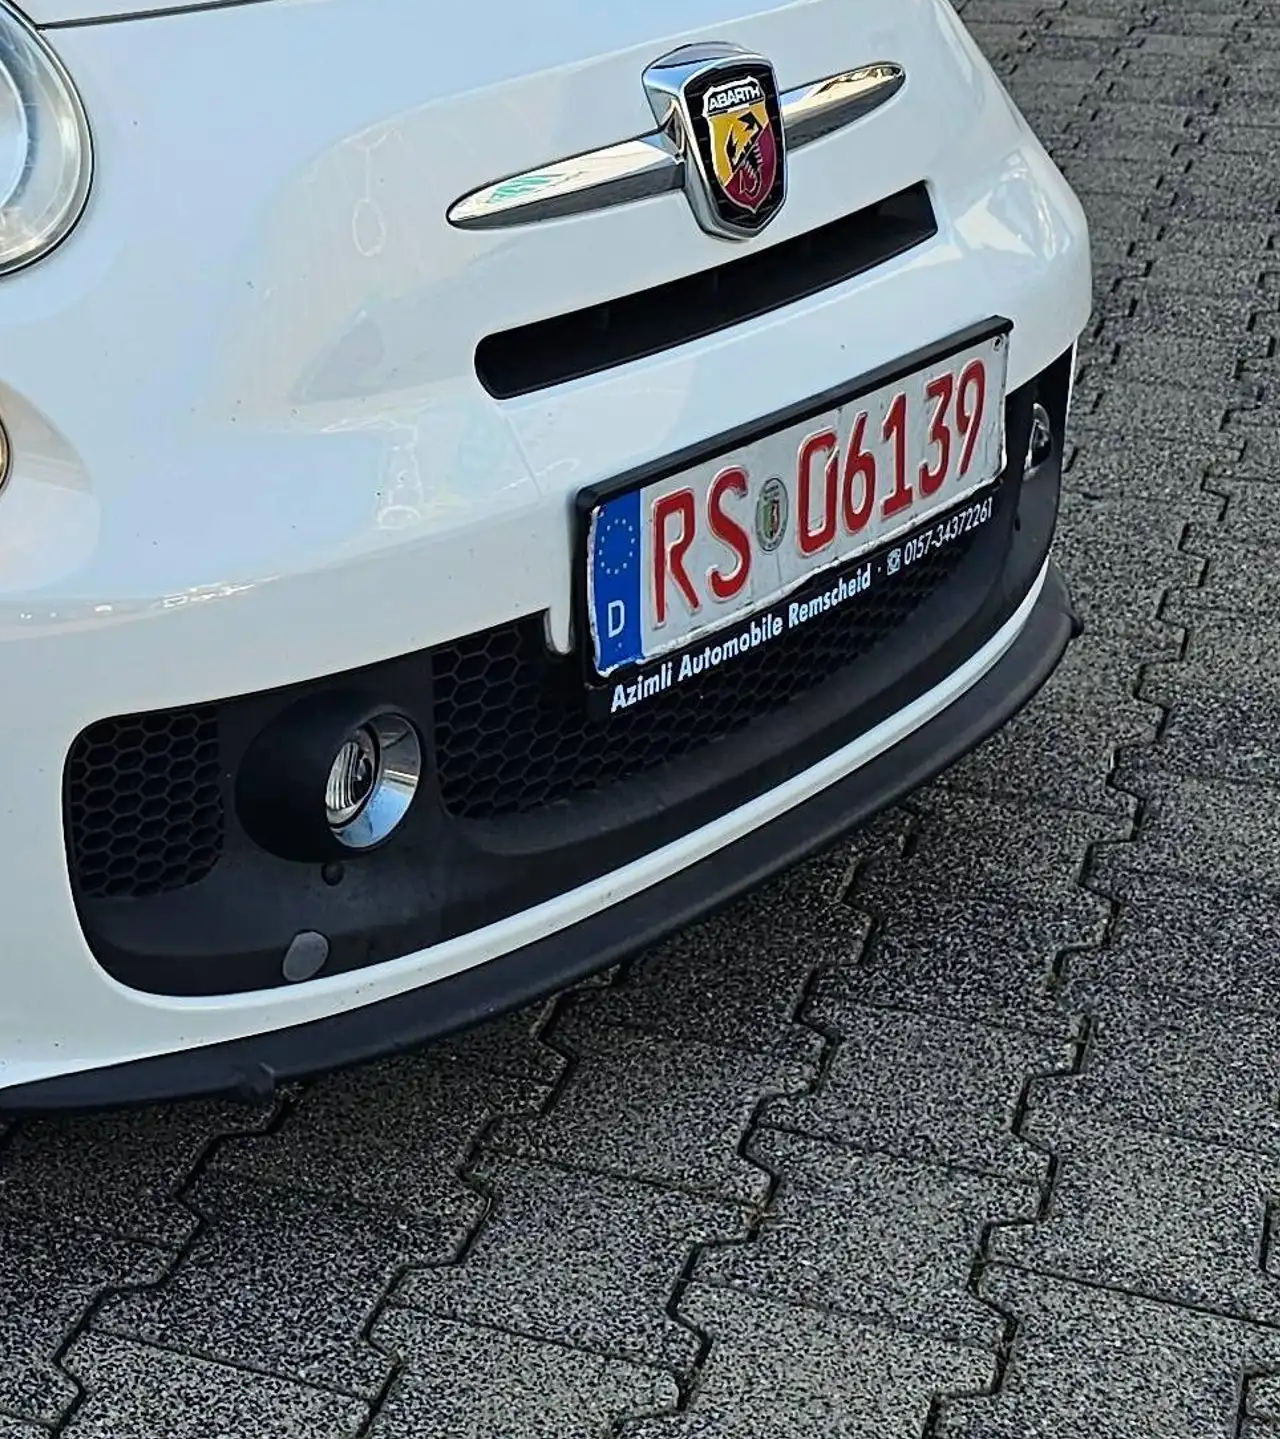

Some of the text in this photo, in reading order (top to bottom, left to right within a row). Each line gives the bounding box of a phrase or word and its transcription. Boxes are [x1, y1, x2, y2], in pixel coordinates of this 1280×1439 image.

[709, 87, 760, 110] ABARTH
[651, 466, 751, 628] RS
[797, 359, 986, 557] 06139
[607, 599, 625, 638] D
[611, 497, 993, 712] Azimli Automobile Remscheid 0157-34372261
